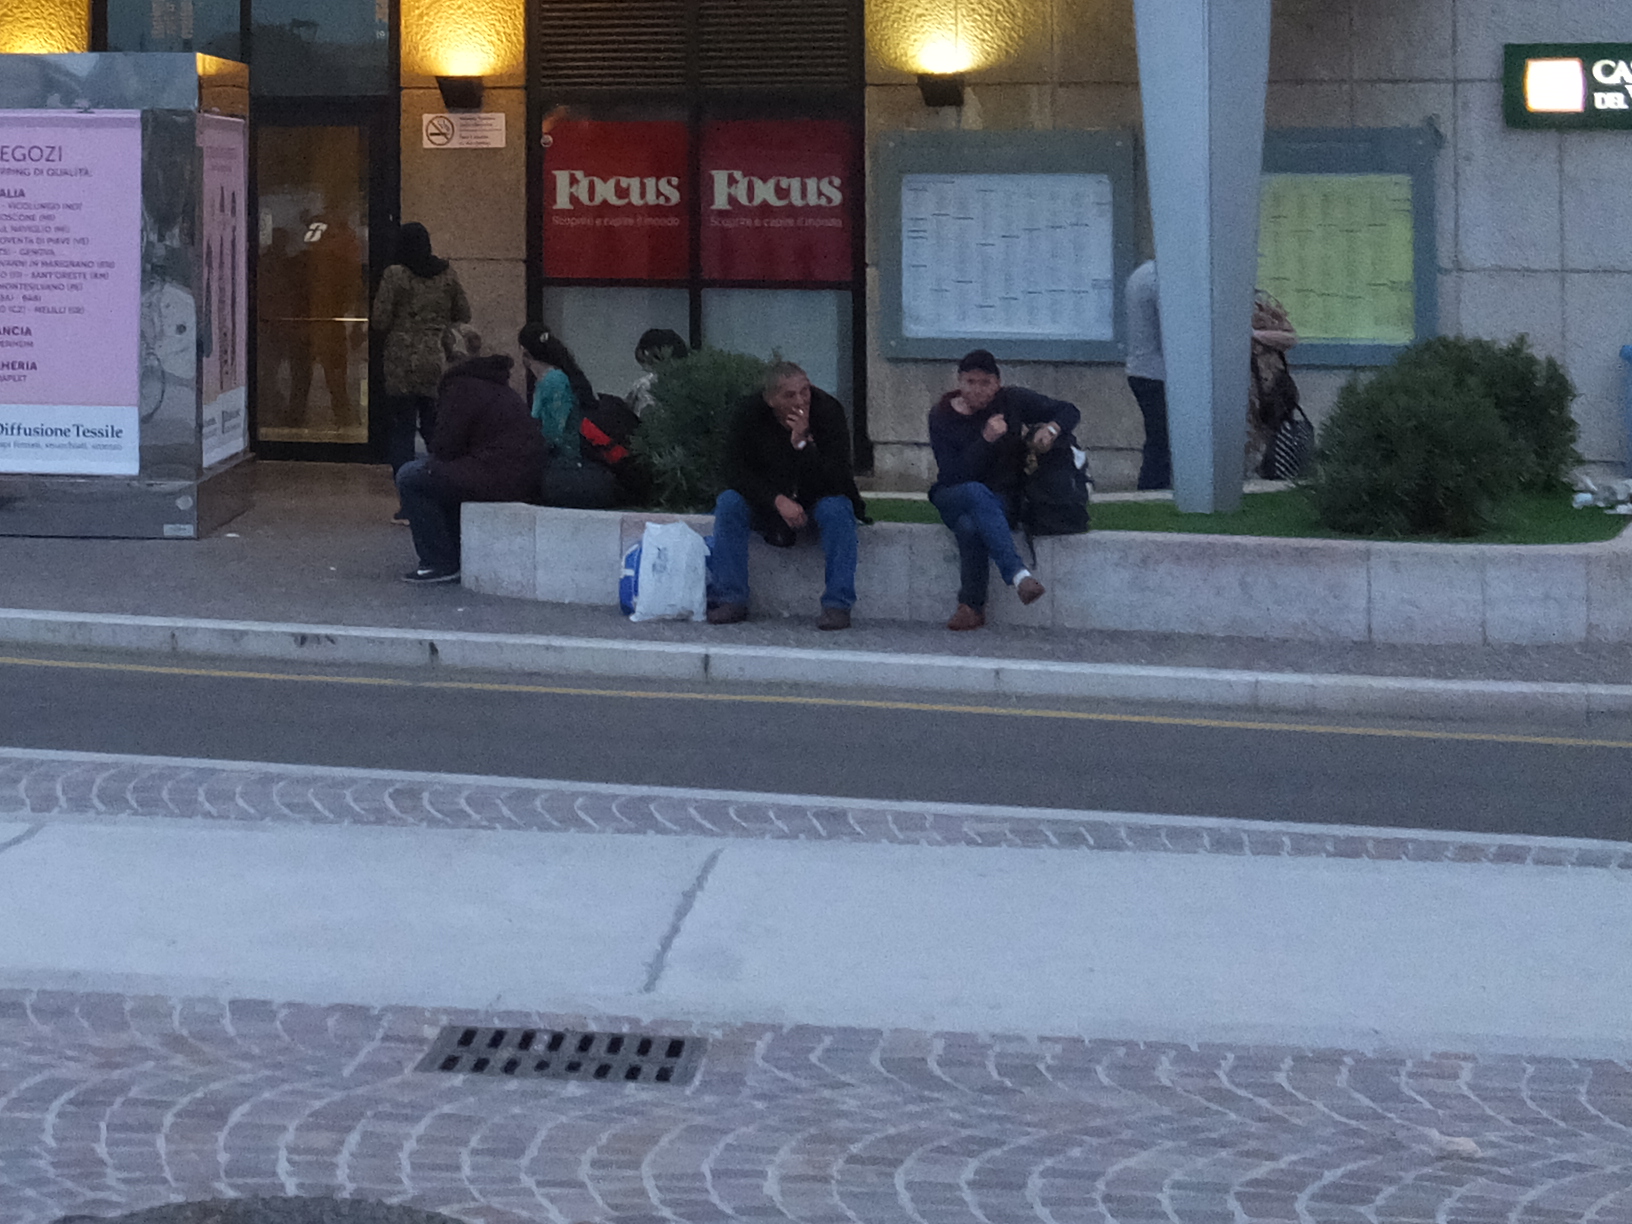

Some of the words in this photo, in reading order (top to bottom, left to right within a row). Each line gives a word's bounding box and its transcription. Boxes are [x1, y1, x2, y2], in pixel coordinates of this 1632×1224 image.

[551, 170, 681, 210] Focus
[709, 169, 843, 210] Focus
[72, 424, 123, 439] Tessile
